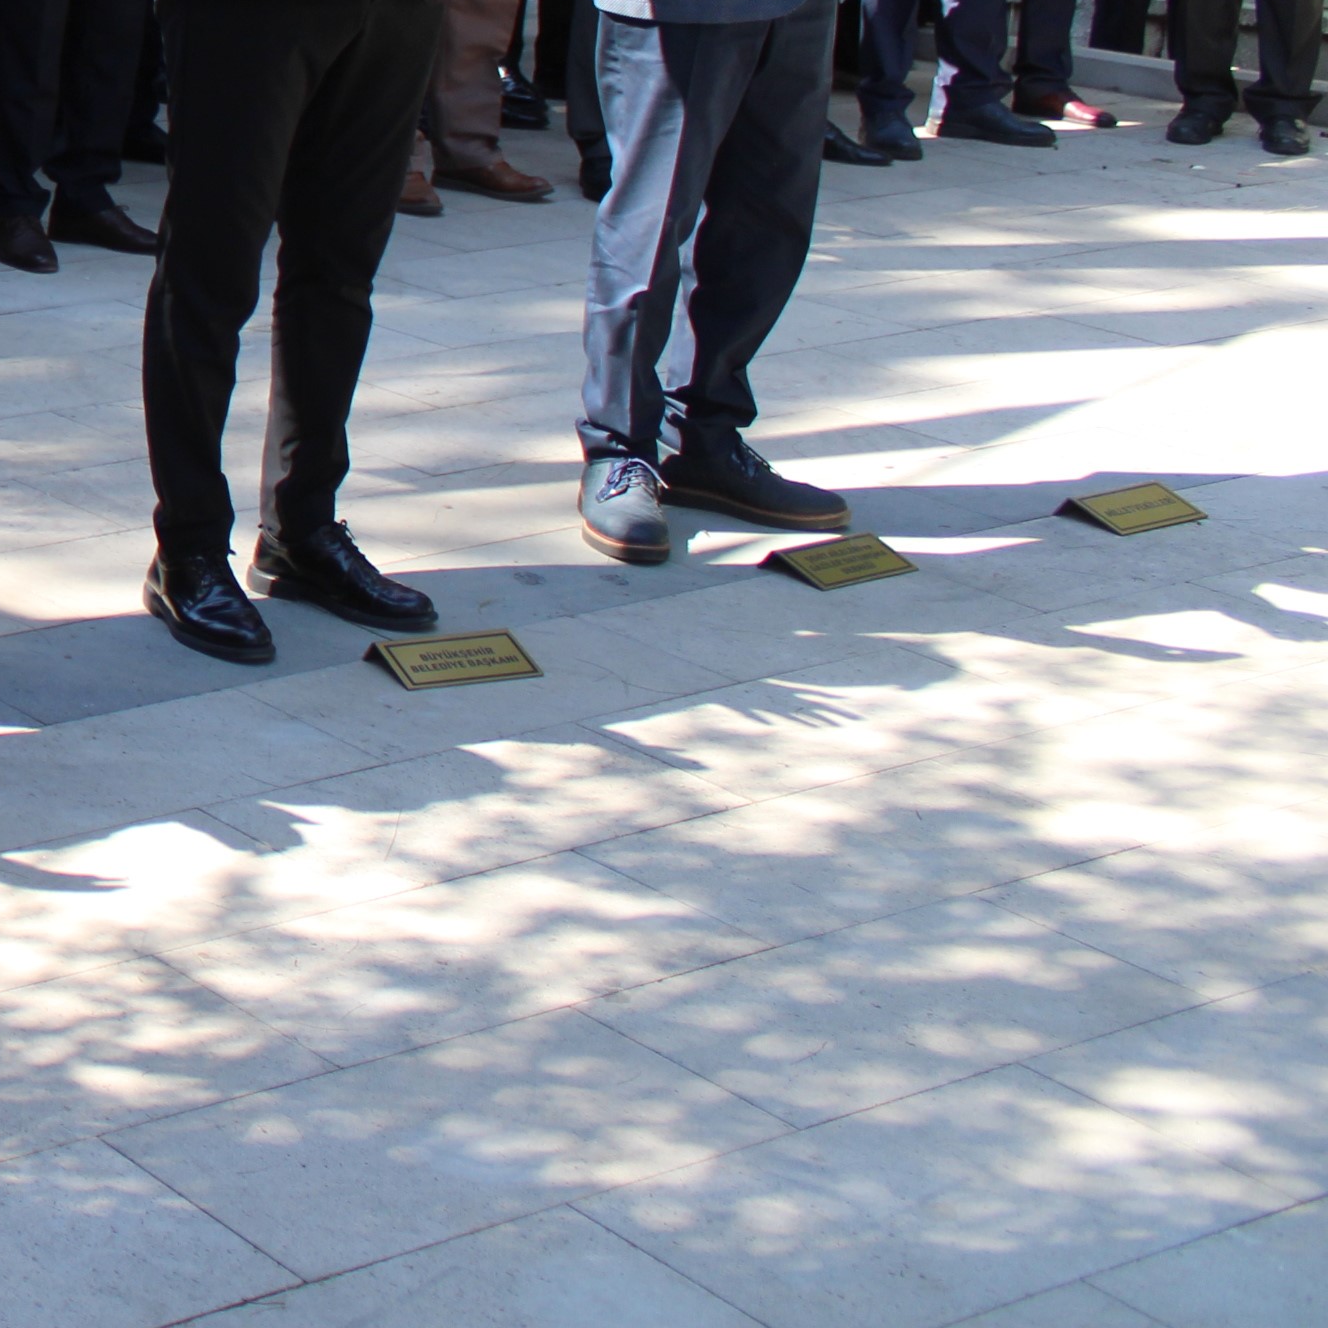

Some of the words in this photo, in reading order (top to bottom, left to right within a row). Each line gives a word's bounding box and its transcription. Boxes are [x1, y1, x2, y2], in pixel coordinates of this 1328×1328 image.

[419, 646, 495, 662] BÜYÜKŞEHİR
[410, 658, 465, 673] BELEDİYE
[467, 655, 519, 668] BAŞKANI
